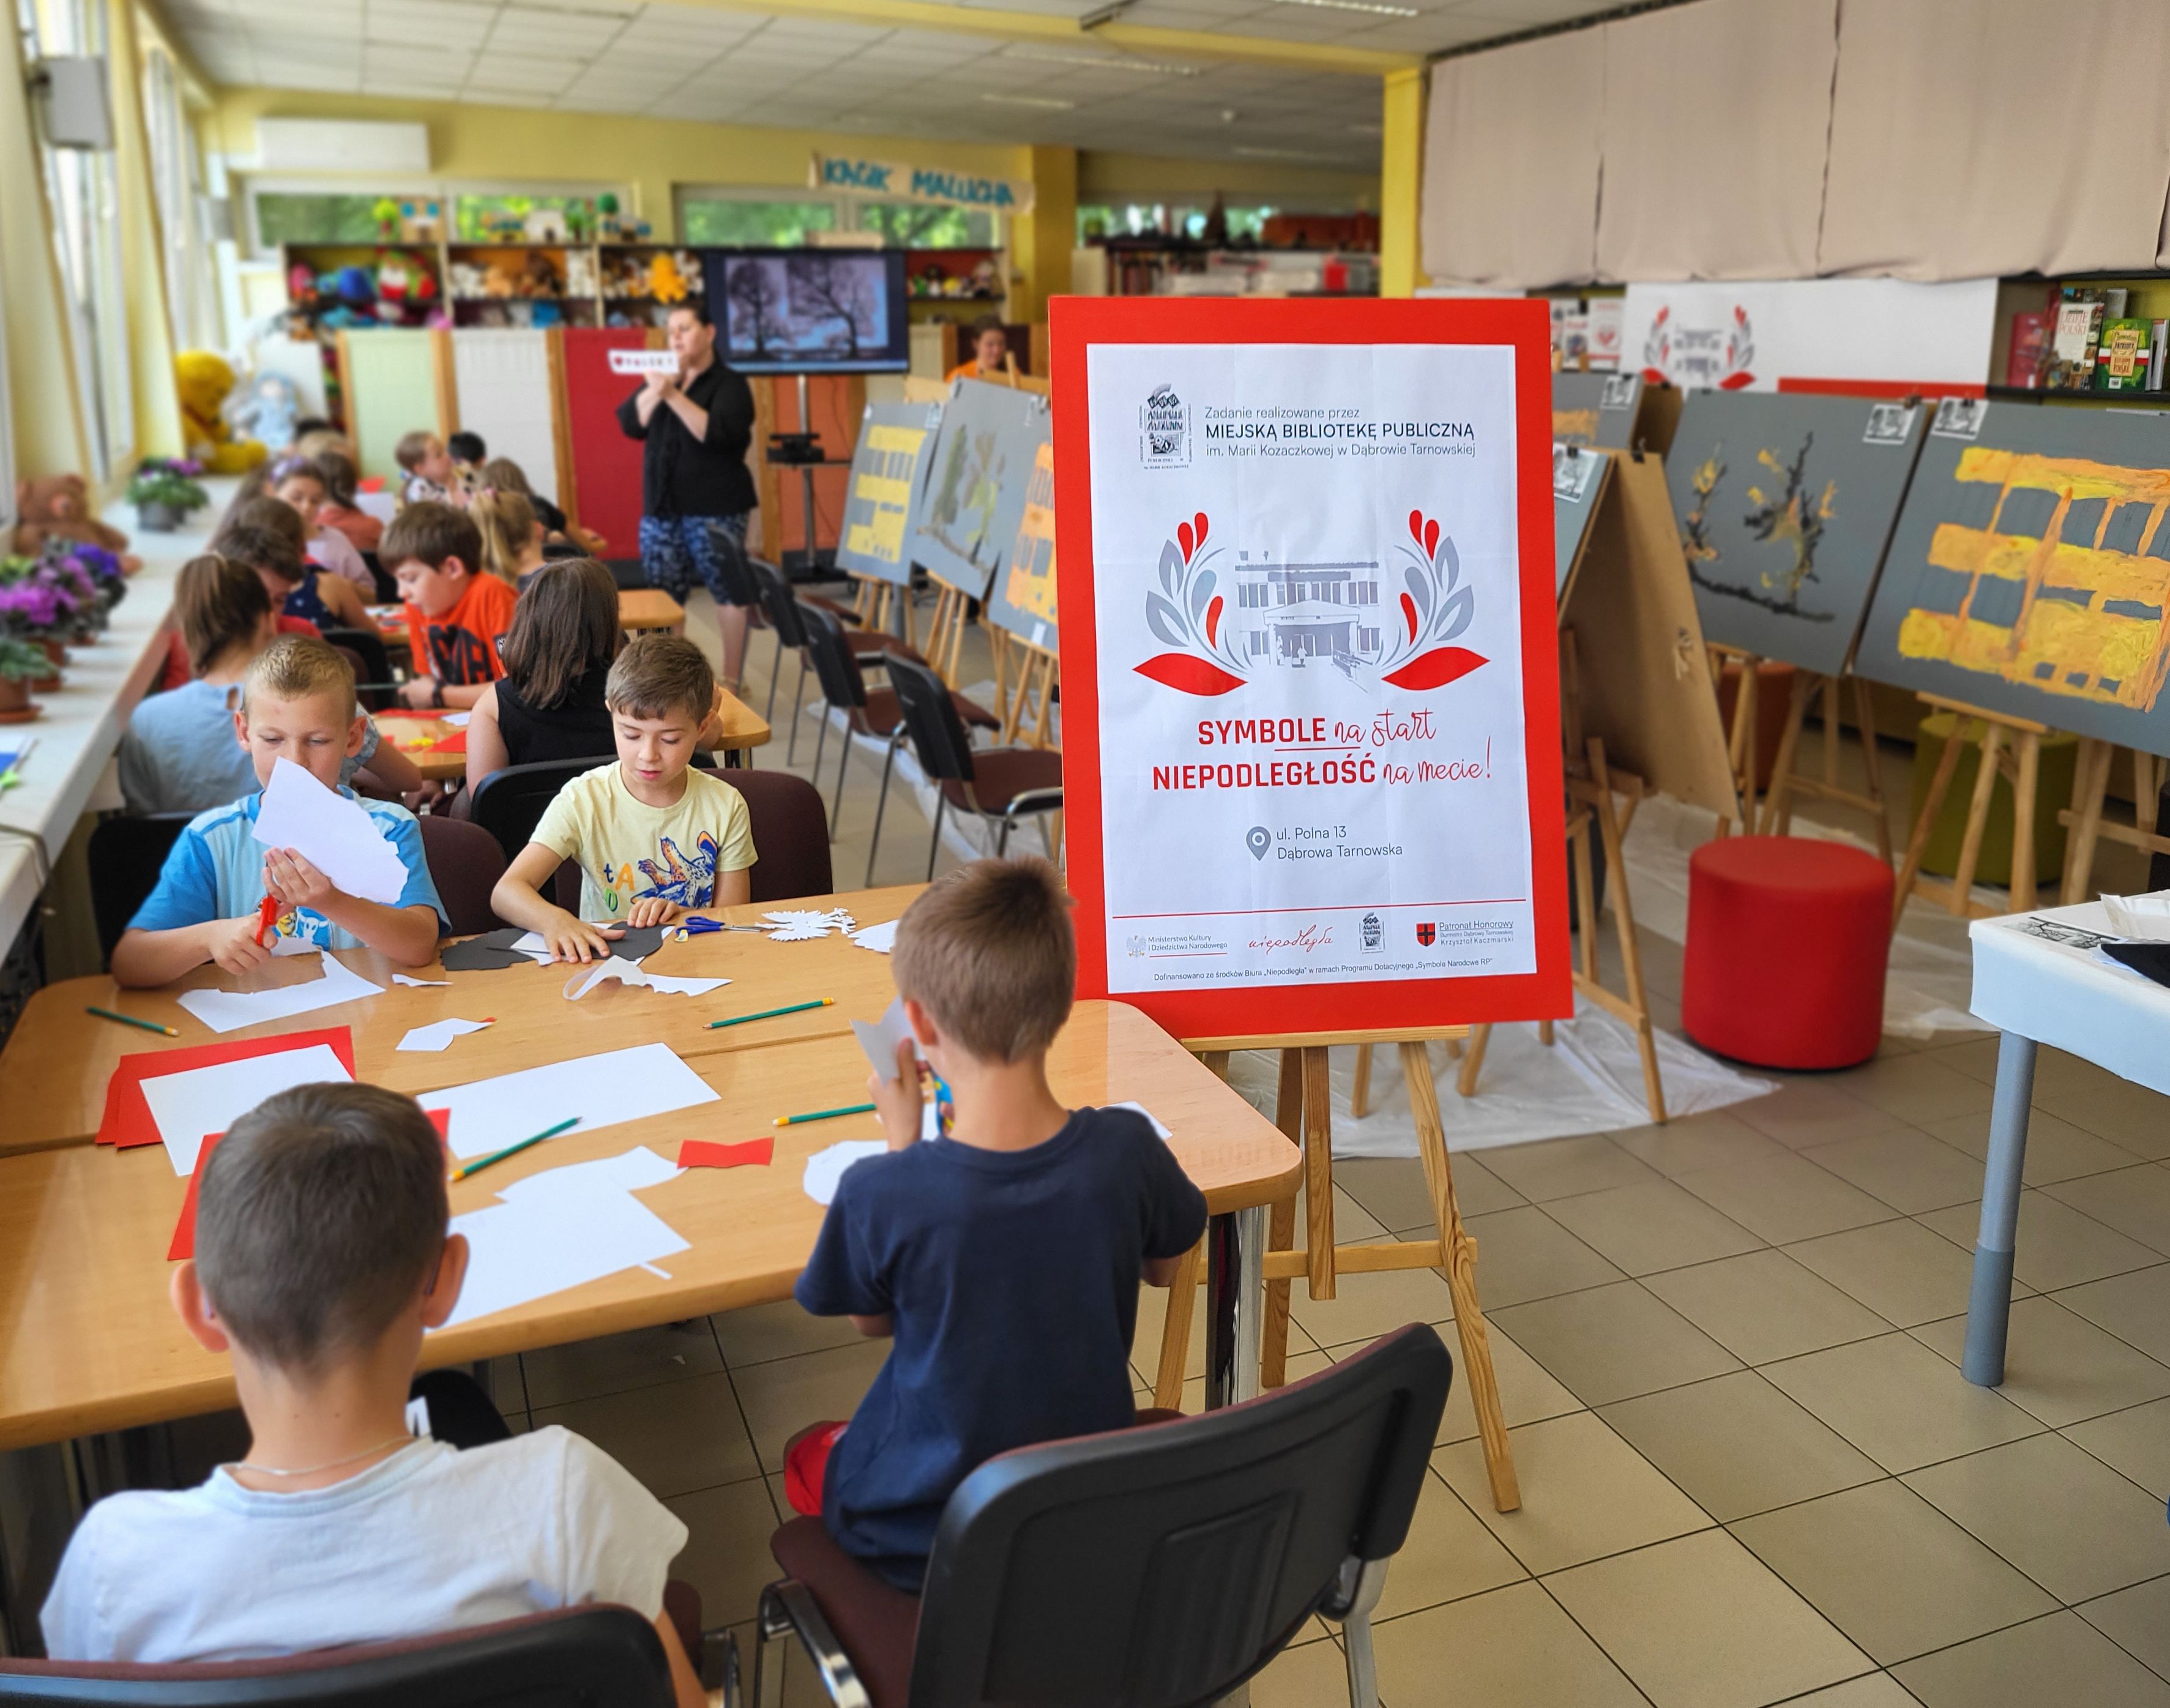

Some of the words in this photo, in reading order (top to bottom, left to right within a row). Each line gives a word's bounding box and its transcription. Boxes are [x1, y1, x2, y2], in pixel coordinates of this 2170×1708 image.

[1205, 406, 1251, 419] Zadanie
[1257, 406, 1324, 418] realizowane
[1329, 409, 1359, 422] przez
[1206, 424, 1277, 443] MIEJSKĄ
[1283, 423, 1376, 441] BIBLIOTEKĘ
[1383, 423, 1474, 439] PUBLICZNĄ
[1207, 444, 1223, 457] im.
[1229, 444, 1255, 456] Marii
[1261, 444, 1333, 459] Kozaczkowej
[1352, 443, 1406, 457] Dąbrowie
[1410, 442, 1475, 458] Tarnowskiej
[1199, 718, 1325, 745] SYMBOLE
[1335, 722, 1366, 743] na
[1372, 707, 1436, 747] start
[1154, 753, 1375, 789] NIEPODLEGŁOŚĆ
[1384, 765, 1414, 785] na
[1277, 827, 1290, 840] ul.
[1296, 827, 1329, 840] Polna
[1333, 826, 1346, 838] 13
[1278, 846, 1332, 861] Dąbrowa
[1337, 843, 1402, 857] Tarnowska
[1474, 920, 1513, 929] Honorowy
[1189, 934, 1211, 942] Kultury
[1441, 938, 1472, 946] Krzysztof
